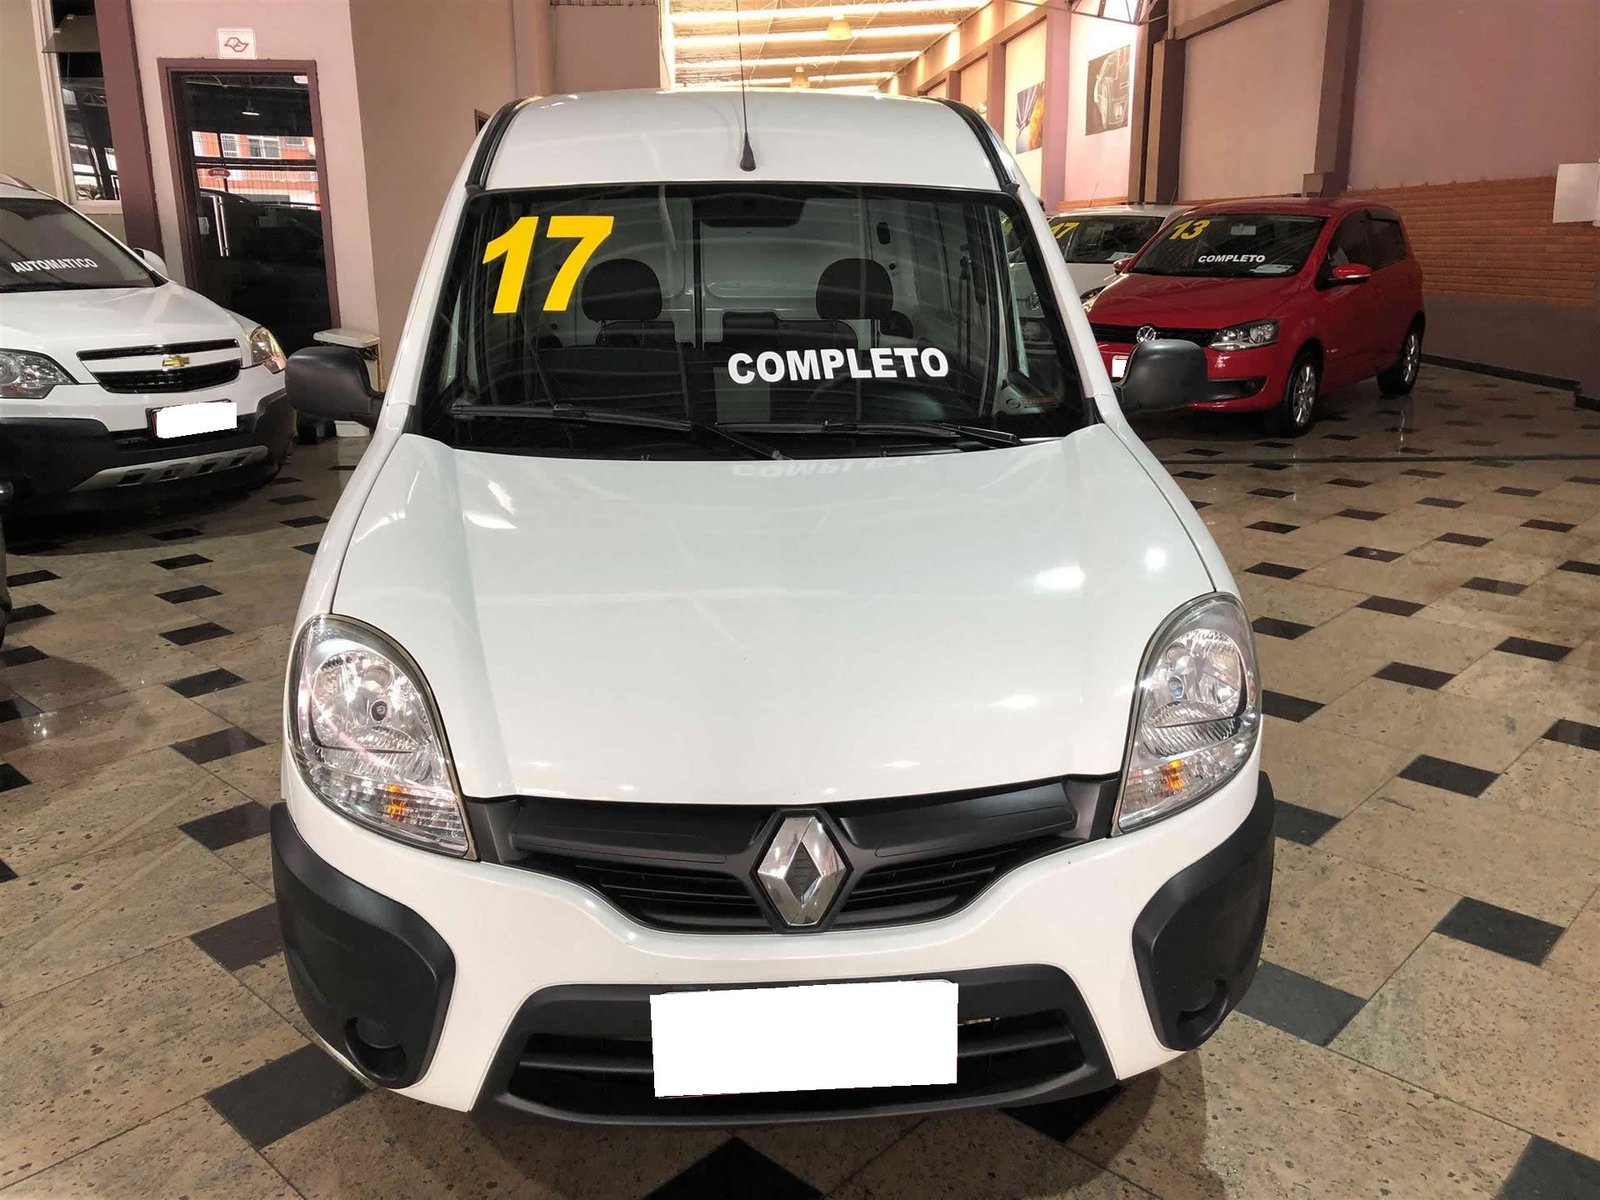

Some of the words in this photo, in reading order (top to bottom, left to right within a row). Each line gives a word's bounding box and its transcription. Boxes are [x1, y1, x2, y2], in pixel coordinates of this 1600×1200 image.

[1169, 219, 1211, 240] 13
[10, 258, 98, 272] AUTOMATICO
[482, 215, 615, 314] 17
[1197, 254, 1266, 263] COMPLETO
[727, 347, 949, 384] COMPLETO
